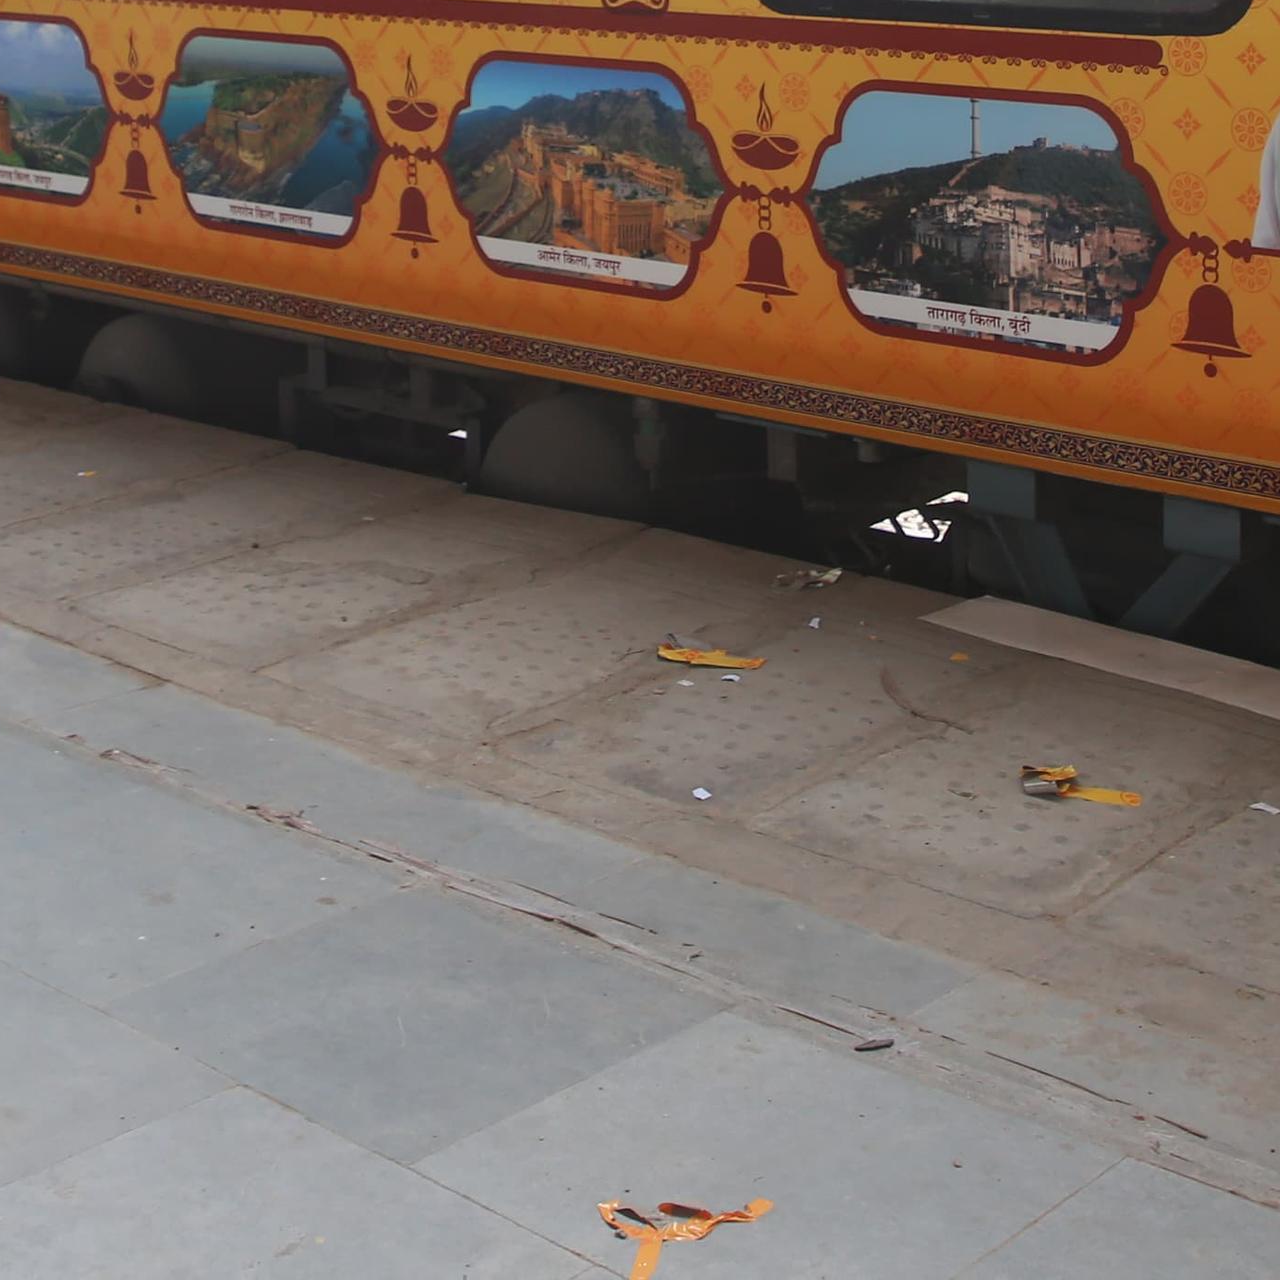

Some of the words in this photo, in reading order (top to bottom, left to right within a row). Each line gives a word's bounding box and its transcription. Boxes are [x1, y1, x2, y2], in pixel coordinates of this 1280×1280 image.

[537, 248, 561, 263] आमेर
[563, 250, 590, 269] किला,
[592, 258, 621, 275] जयपुर
[970, 309, 1004, 332] किला,
